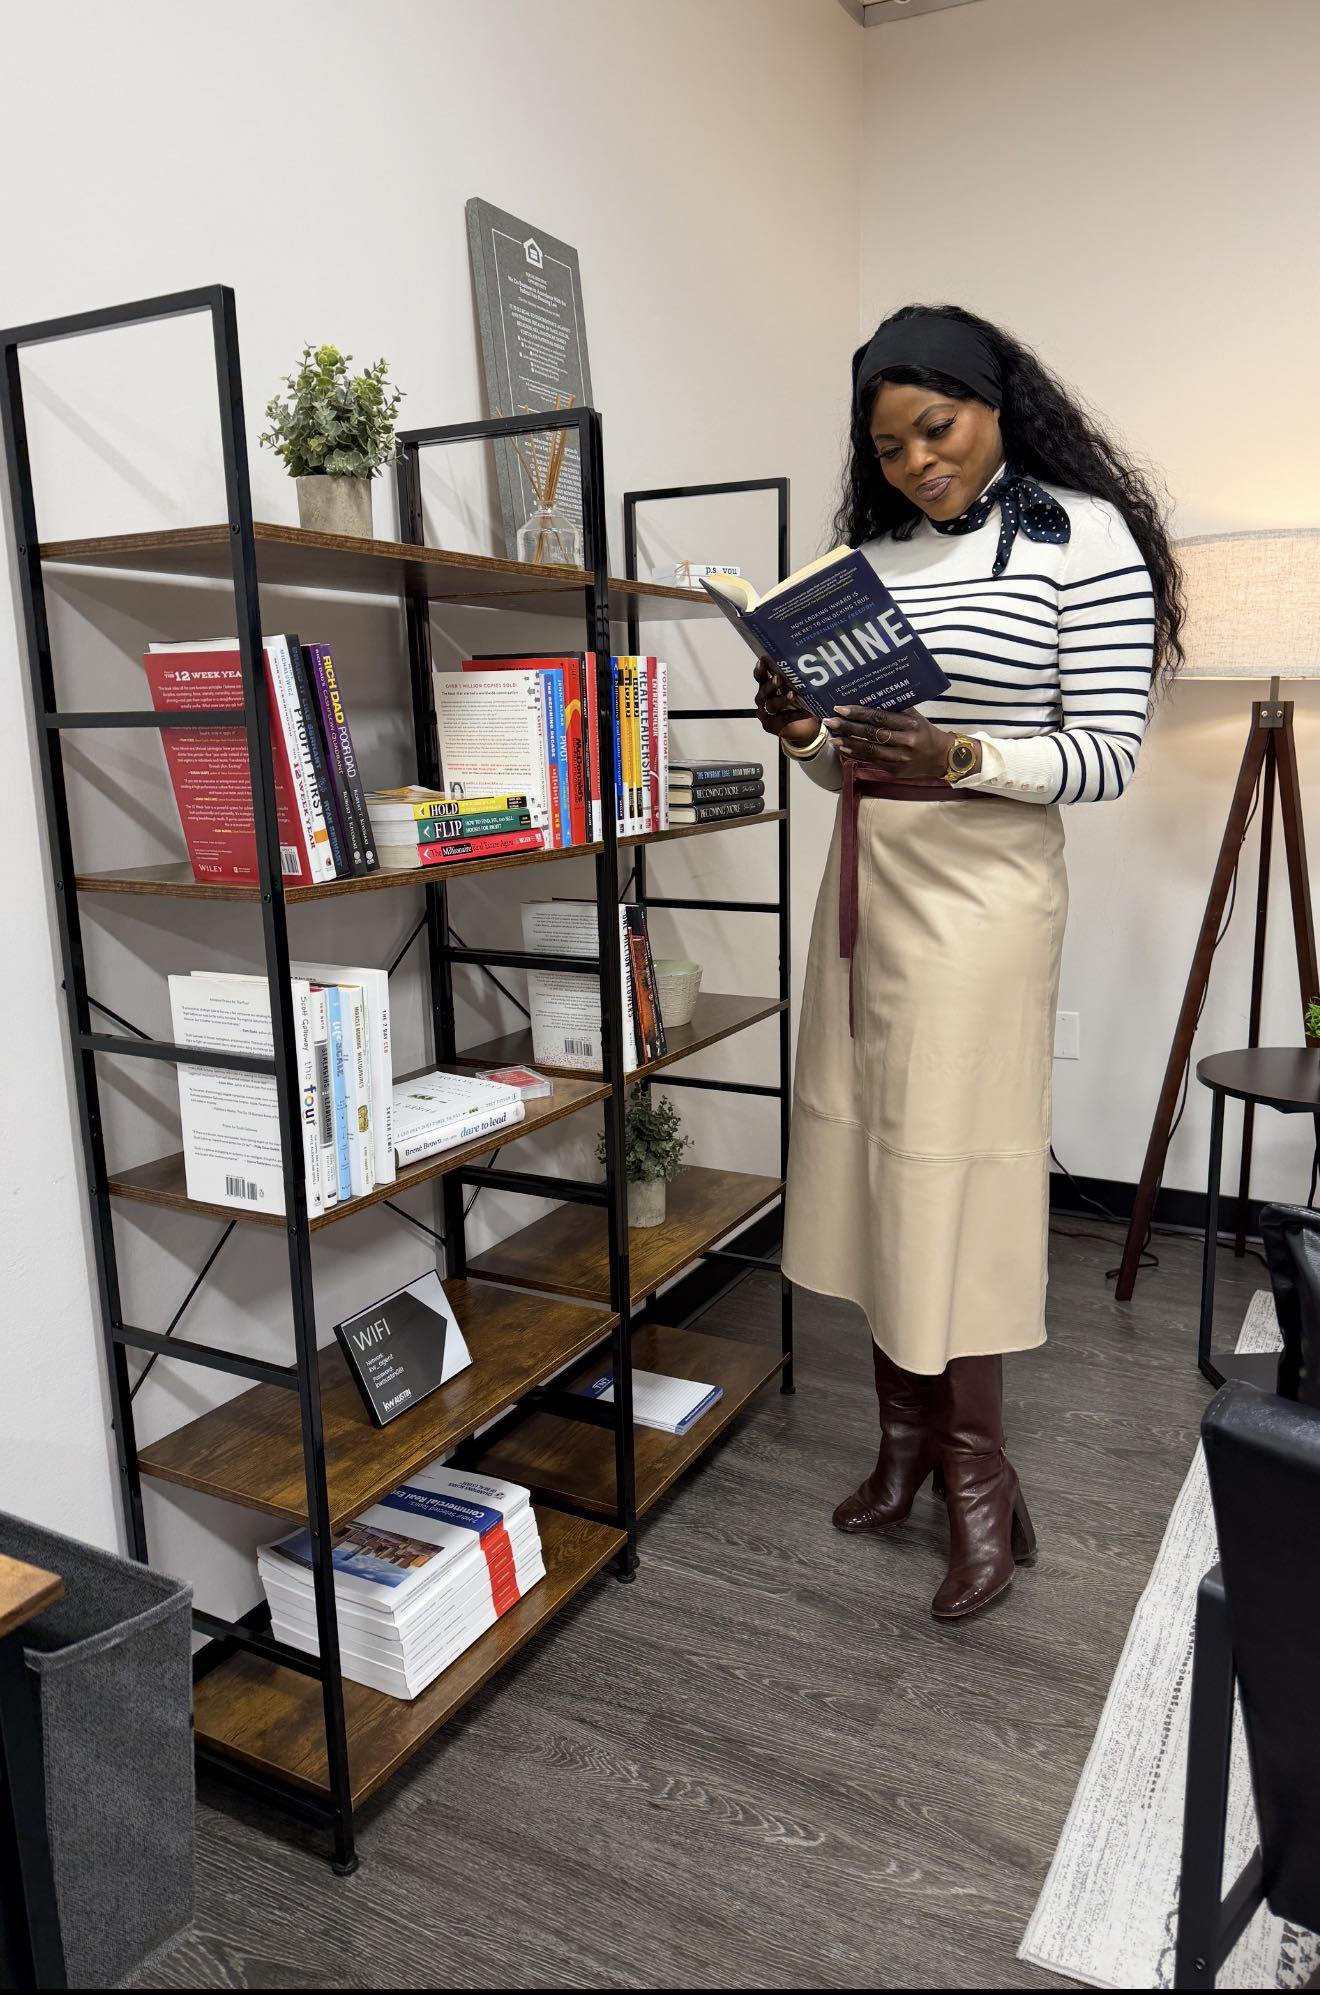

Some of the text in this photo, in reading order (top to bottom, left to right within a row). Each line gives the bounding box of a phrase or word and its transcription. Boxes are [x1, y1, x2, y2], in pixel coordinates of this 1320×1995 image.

[789, 594, 869, 640] THE KEY TO UNLOCKING TRUE
[790, 619, 804, 630] HOW
[803, 606, 828, 623] LOOKING
[828, 594, 852, 610] INWARD
[848, 602, 876, 620] FREEDOM
[797, 607, 914, 688] SHINE
[175, 671, 191, 682] 12
[192, 671, 221, 679] WEEK
[221, 670, 242, 678] YEA
[321, 654, 336, 689] RICH
[777, 660, 807, 690] SHINE
[840, 675, 865, 690] Disciplines
[871, 660, 898, 676] Maximizing
[874, 673, 885, 681] and
[894, 661, 910, 672] Peace
[858, 677, 910, 705] GINO WICKMAN
[882, 690, 916, 709] ROB DUBE
[329, 690, 344, 724] DAD
[337, 726, 351, 755] POOR
[638, 671, 651, 791] REAL LEADERSHIP
[292, 707, 311, 766] PROFIT
[306, 772, 323, 818] FIRST
[314, 648, 322, 665] RICH
[322, 689, 335, 731] CASHFLOW
[330, 732, 343, 774] QUADRANT
[342, 790, 350, 814] ROBERT
[348, 822, 357, 849] KIYOSAKI
[559, 735, 567, 763] PIVOT
[306, 723, 322, 769] SERHANT
[322, 800, 332, 823] RYAN
[343, 755, 356, 778] DAD
[293, 762, 316, 849] 12 WEEK YEAR
[696, 786, 739, 799] BECOMING MORE
[430, 802, 458, 818] HOLD
[700, 803, 741, 818] BECOMING MORE
[358, 818, 368, 845] KIYOSAKI
[433, 819, 463, 839] FLIP
[430, 847, 441, 857] The
[442, 842, 472, 856] Millionaire
[198, 864, 223, 873] WILEY
[622, 933, 630, 967] MILLION
[624, 970, 633, 1018] FOLLOWERS
[300, 1019, 310, 1051] Galloway
[304, 1061, 313, 1079] the
[356, 1051, 364, 1088] MILLIONAIRES
[303, 1084, 318, 1126] four
[320, 1048, 332, 1139] STRENGTHS LEADERSHIP
[405, 1112, 507, 1156] Brené Brown dare to lead
[352, 1318, 391, 1351] WIFI
[382, 1388, 412, 1411] kw AUSTIN
[405, 1491, 428, 1503] Real
[448, 1482, 493, 1497] CHAMPIONS SCHOOL
[409, 1500, 478, 1524] 7-Hour Selected Topics:
[428, 1498, 486, 1519] Commercial
